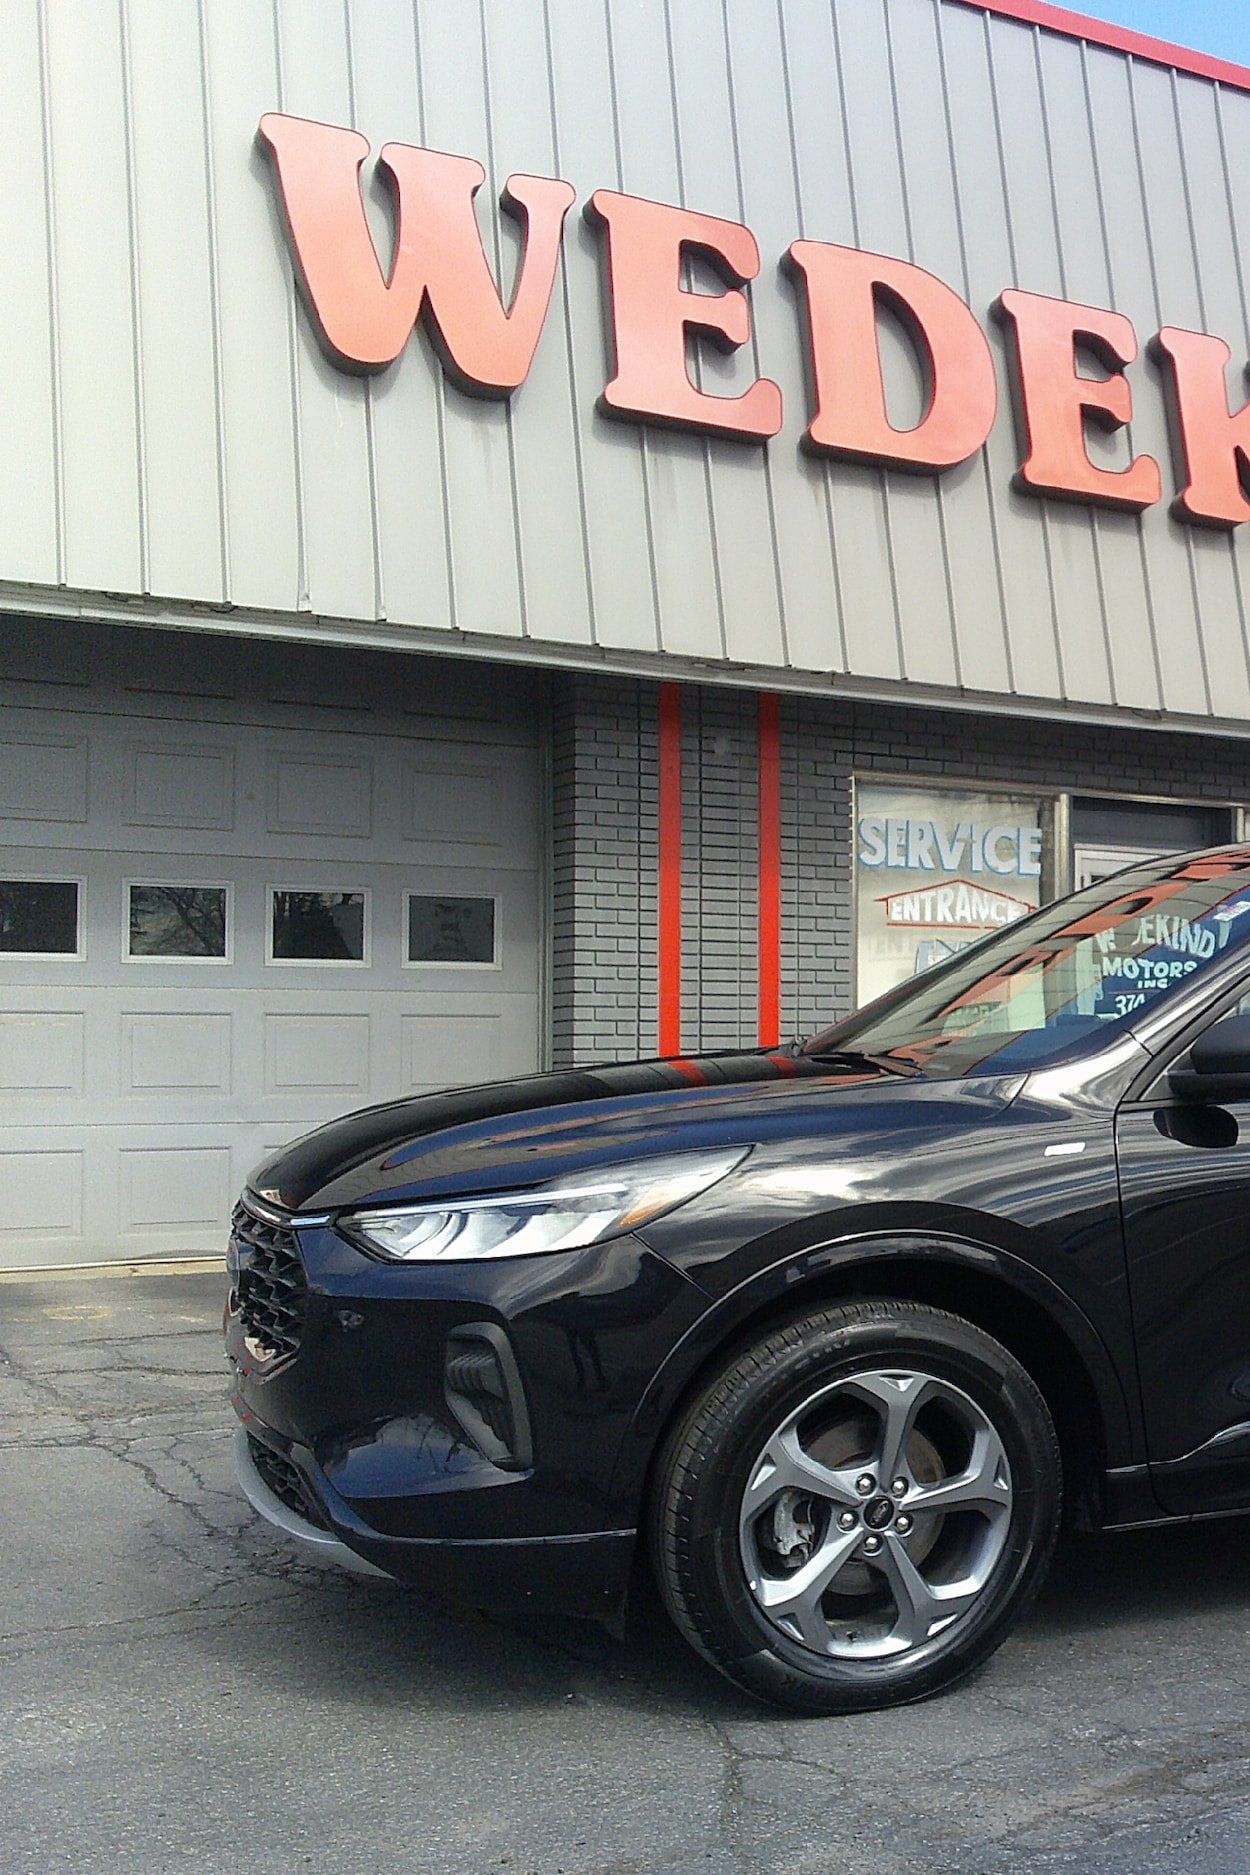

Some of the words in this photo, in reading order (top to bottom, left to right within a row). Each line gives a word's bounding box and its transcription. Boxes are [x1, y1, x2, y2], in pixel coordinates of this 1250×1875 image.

[859, 818, 1042, 877] SERVICE
[891, 884, 1022, 924] ENTRANCE
[1102, 956, 1198, 980] MOTORS
